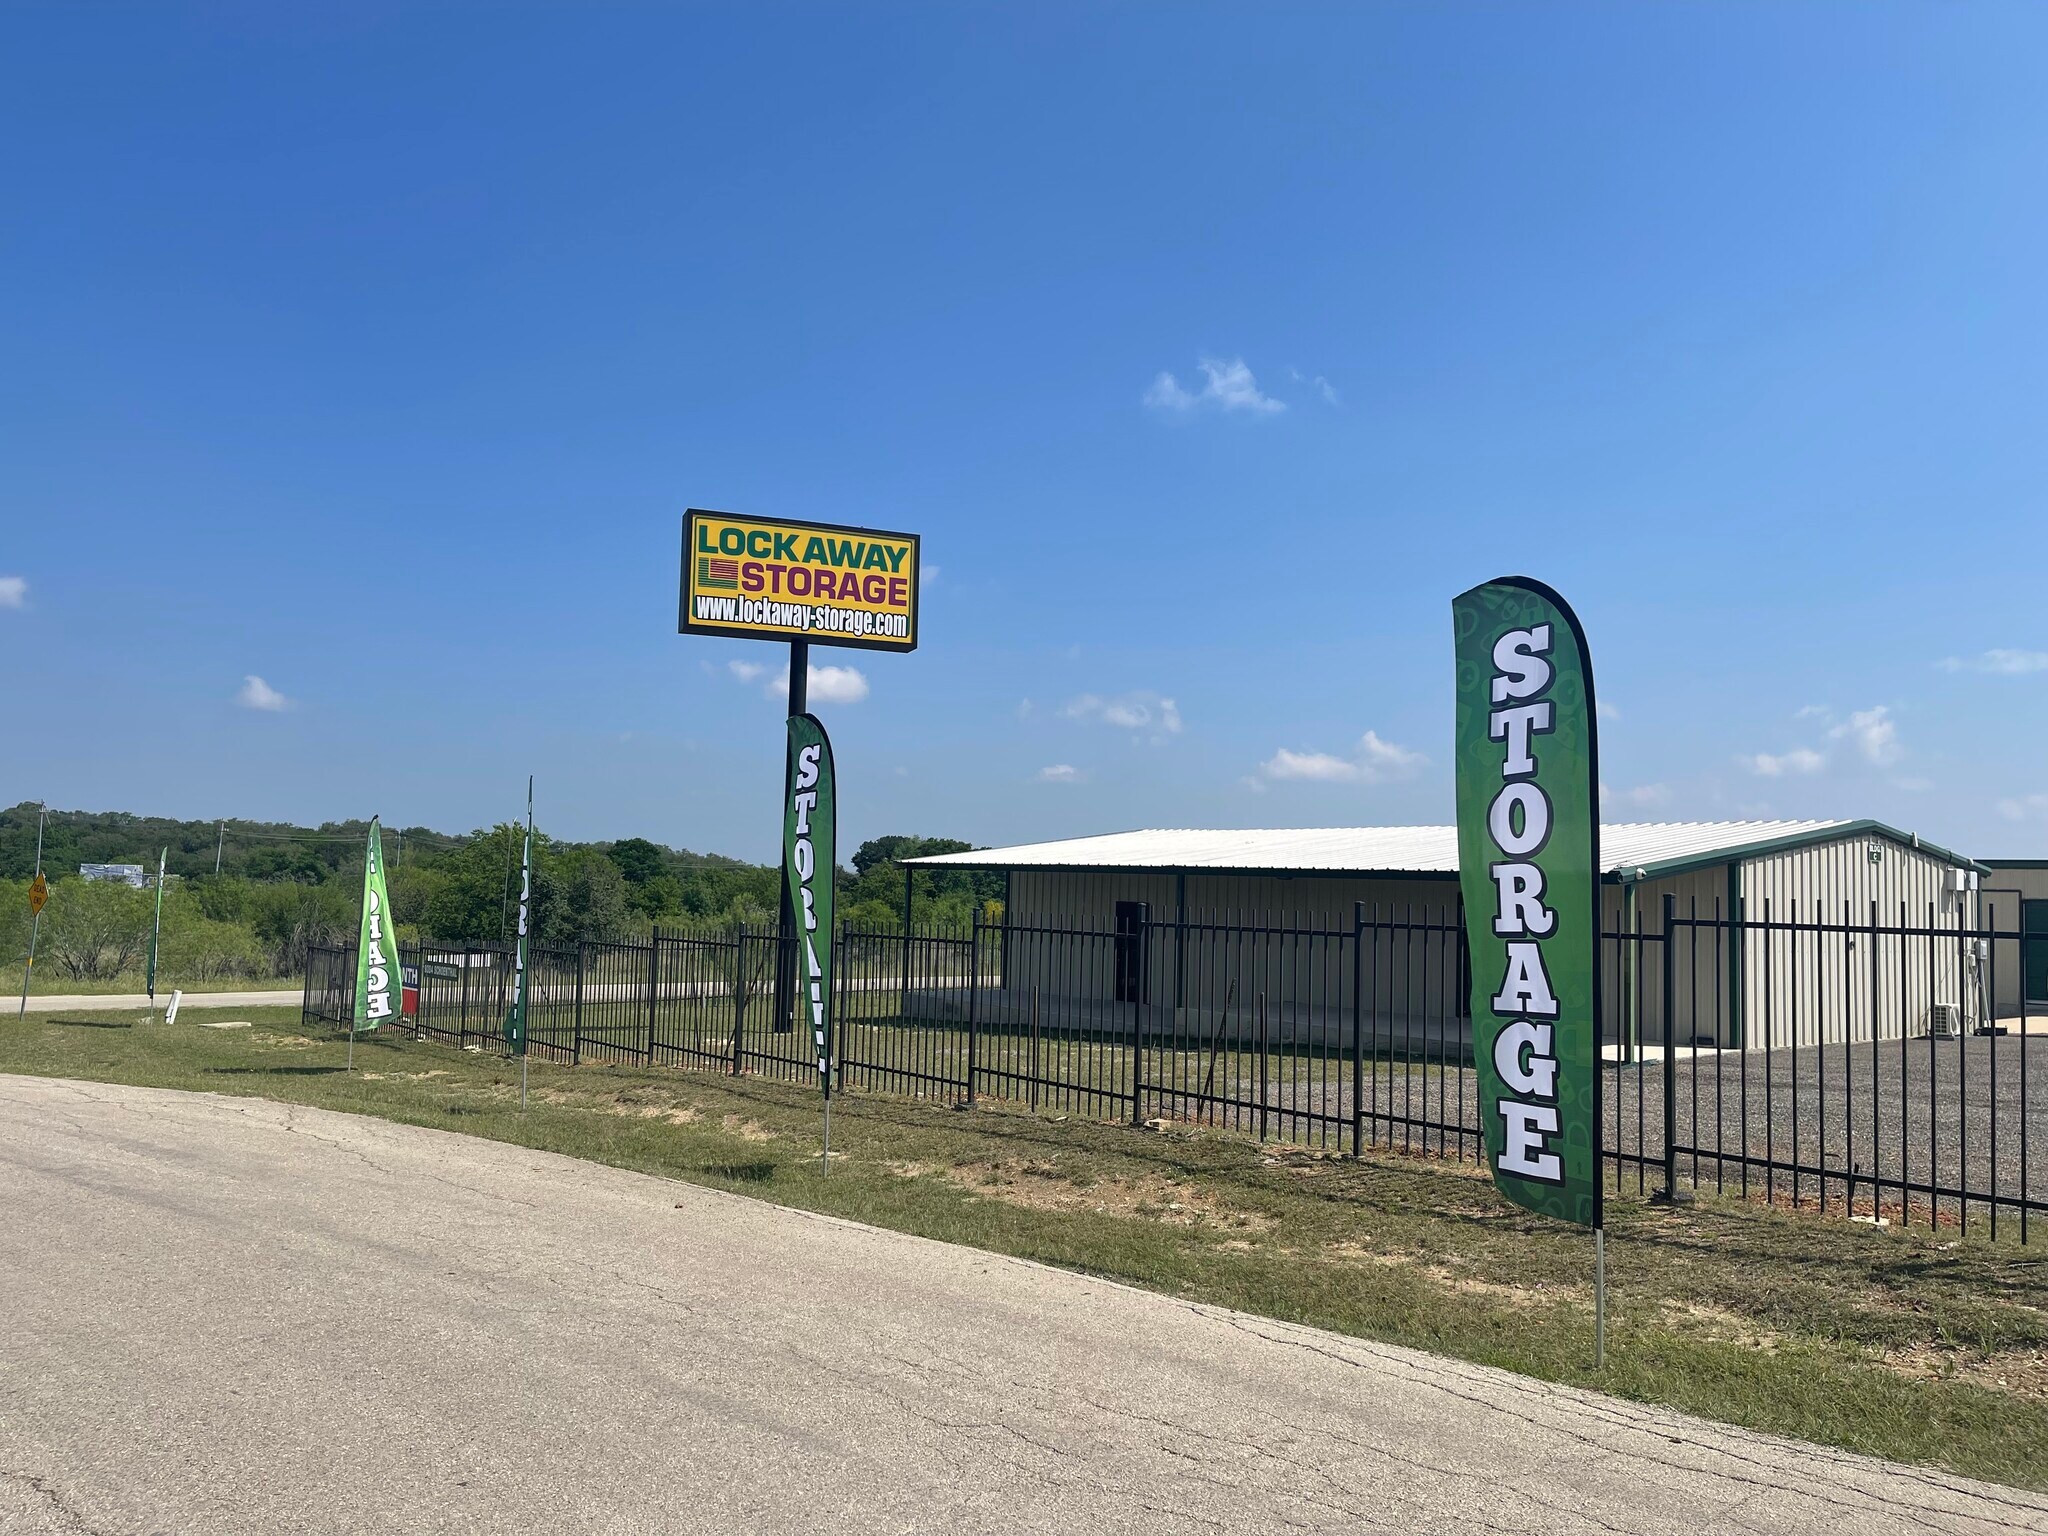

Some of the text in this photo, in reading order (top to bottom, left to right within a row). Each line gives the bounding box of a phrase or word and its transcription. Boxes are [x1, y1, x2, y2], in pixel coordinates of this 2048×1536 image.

[698, 524, 909, 573] LOCKAWAY
[741, 561, 908, 607] STORAGE
[696, 595, 908, 638] www.lockaway-storage.com
[1873, 853, 1878, 861] C
[33, 895, 42, 905] END
[34, 884, 45, 894] DEAD
[1490, 624, 1563, 1182] STORAGE
[402, 967, 418, 985] NTH
